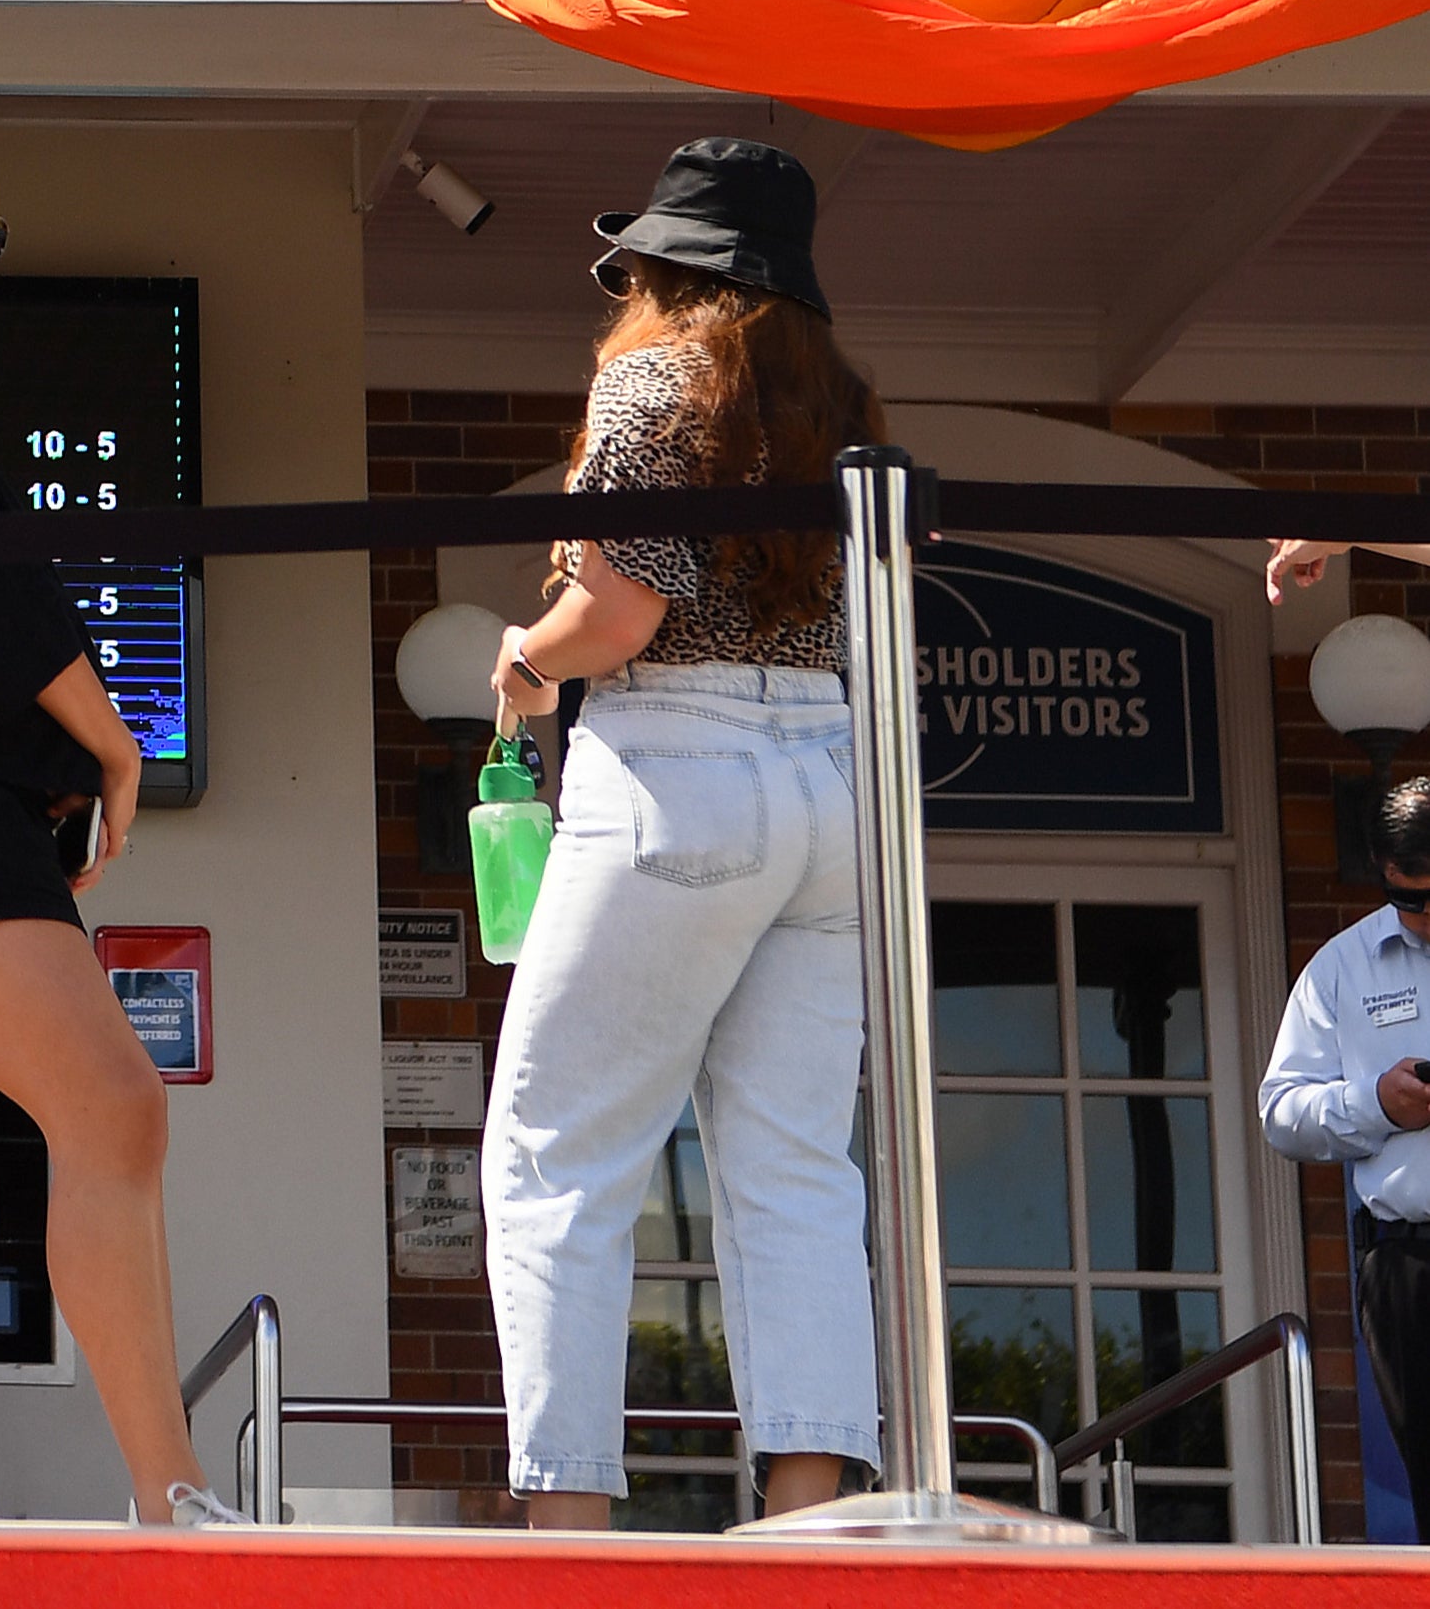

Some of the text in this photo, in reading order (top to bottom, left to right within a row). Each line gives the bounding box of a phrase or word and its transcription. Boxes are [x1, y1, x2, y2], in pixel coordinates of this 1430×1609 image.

[27, 430, 66, 460] 10
[97, 430, 117, 461] 5
[27, 482, 66, 511] 10
[97, 482, 117, 511] 5
[99, 586, 119, 616] 5
[99, 639, 120, 668] 5
[942, 694, 1150, 738] VISITORS
[406, 921, 453, 936] NOTICE
[414, 949, 453, 959] UNDER
[391, 961, 424, 971] HOUR
[122, 997, 185, 1009] CONTACTLESS
[429, 1161, 466, 1175] FOOD
[427, 1178, 446, 1191] OR
[404, 1197, 471, 1210] BEVERAGE
[422, 1214, 455, 1228] PAST
[435, 1234, 474, 1247] POINT
